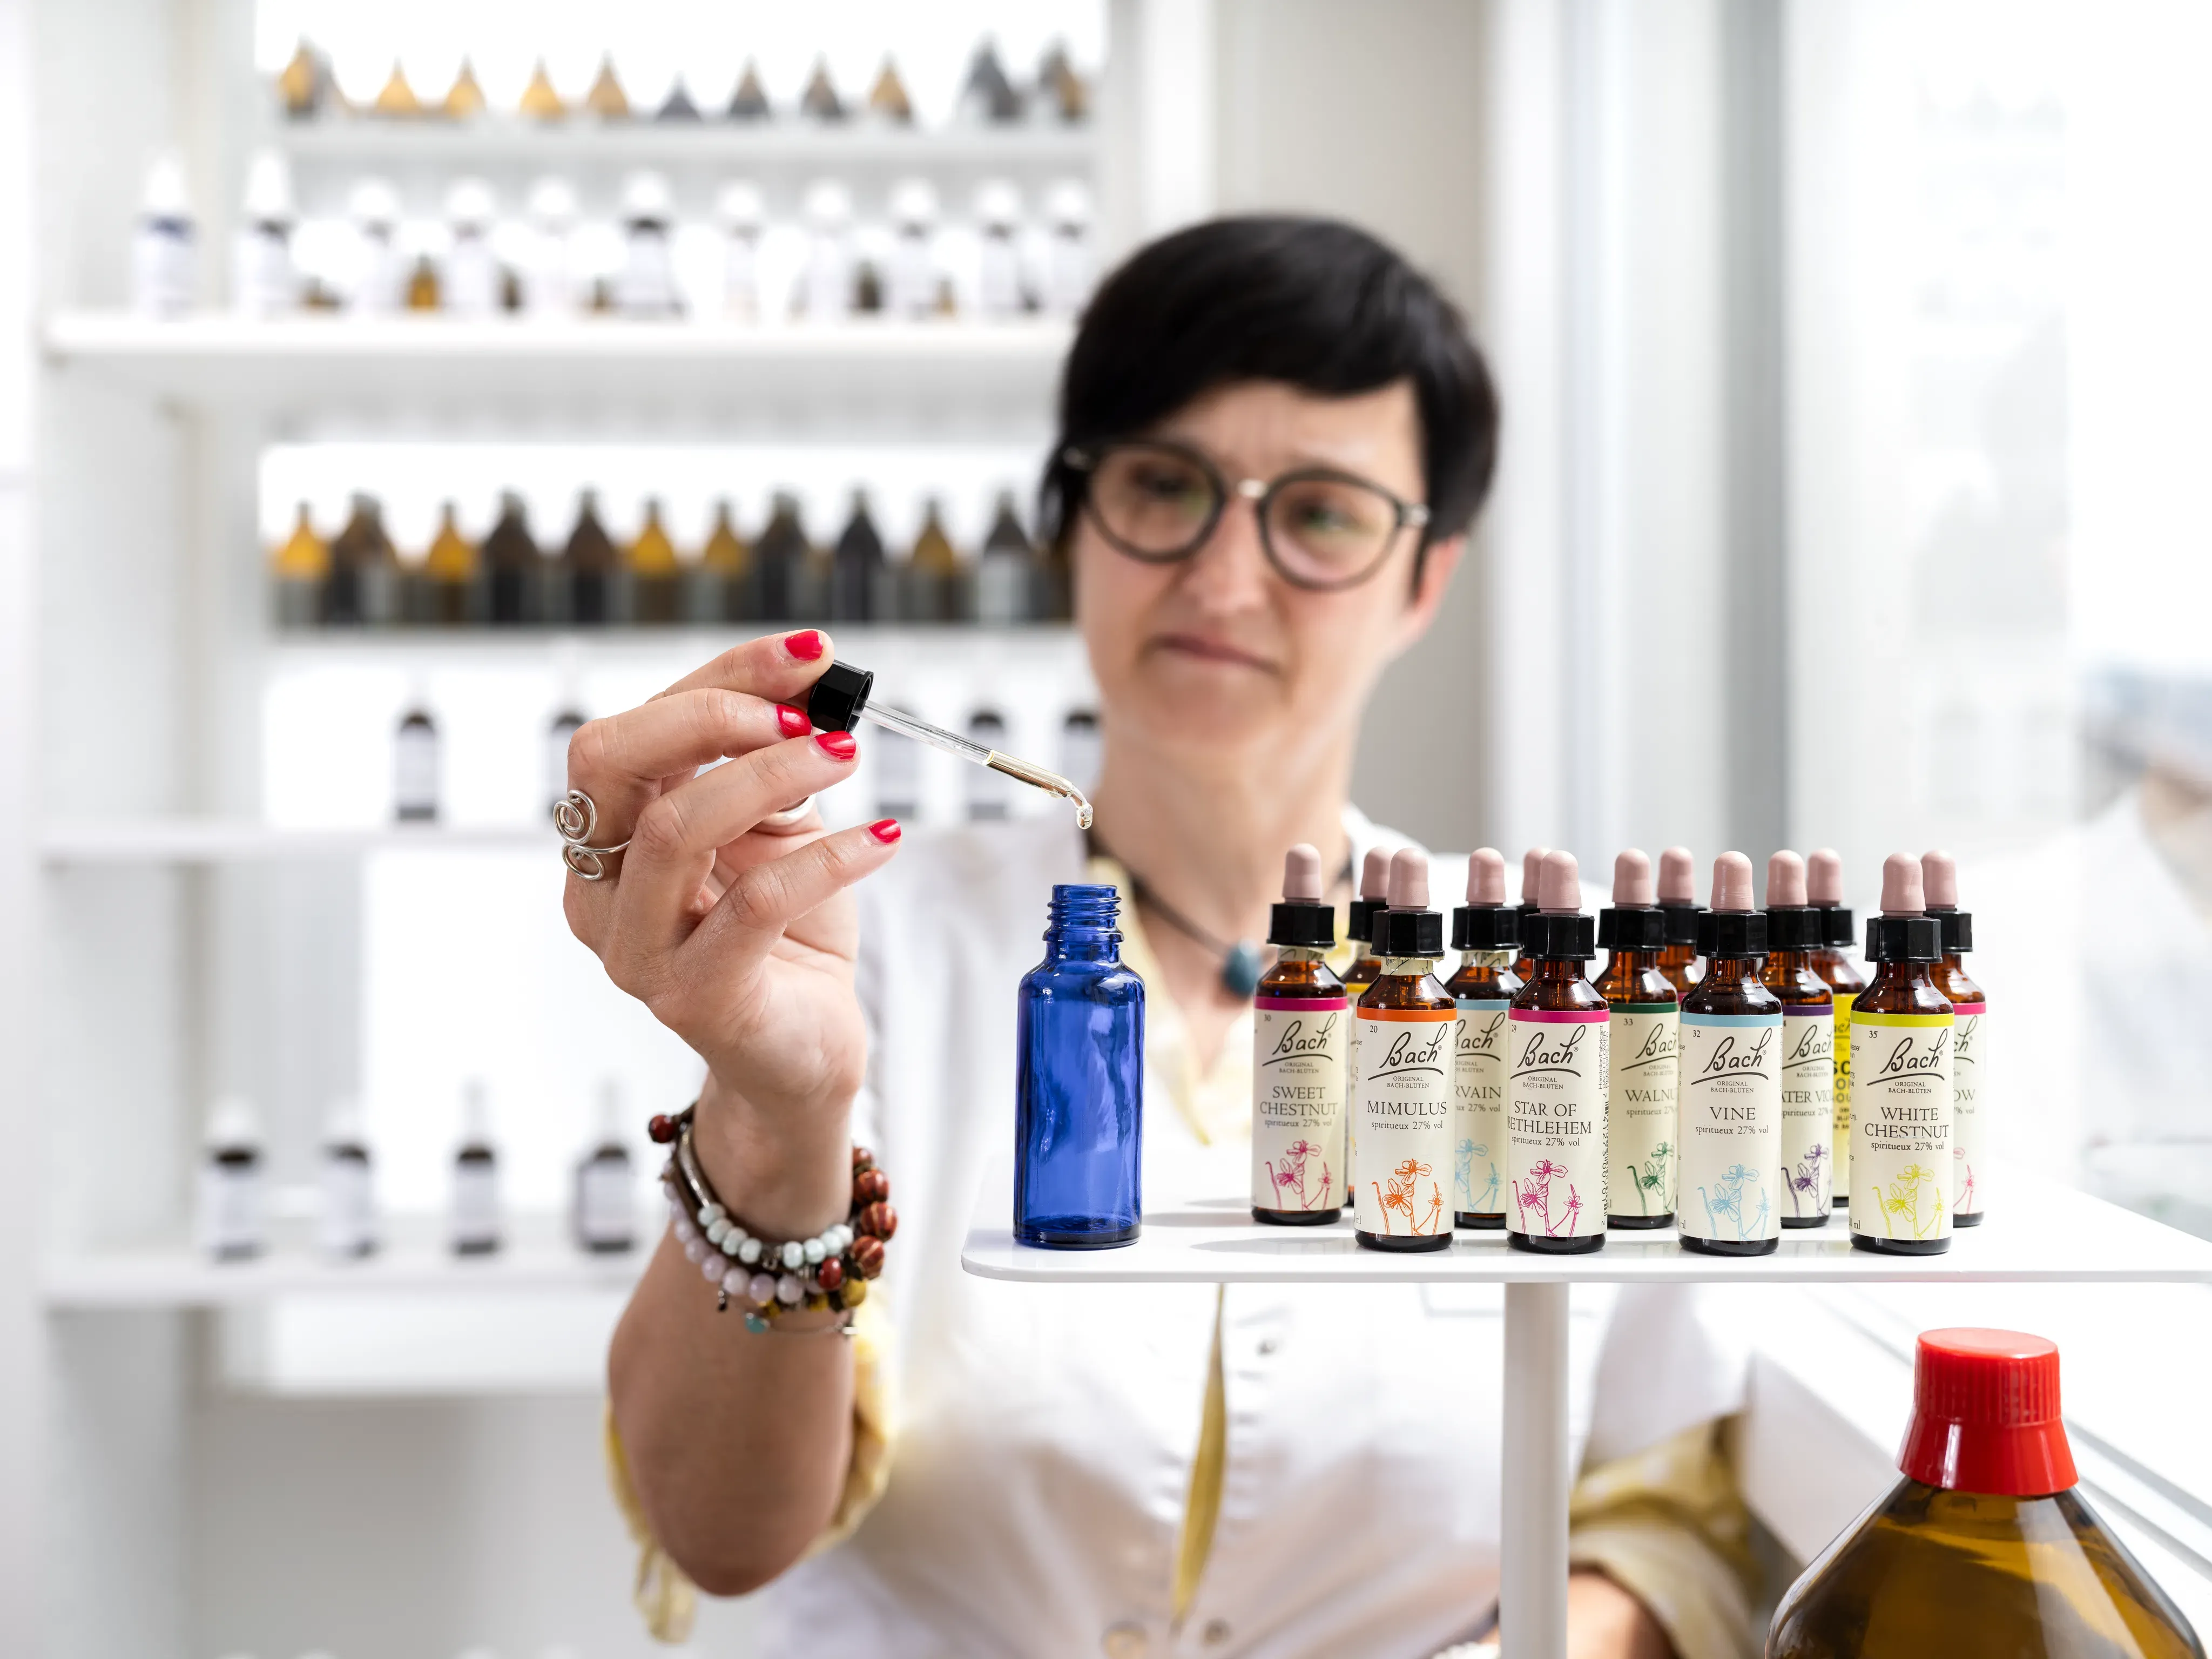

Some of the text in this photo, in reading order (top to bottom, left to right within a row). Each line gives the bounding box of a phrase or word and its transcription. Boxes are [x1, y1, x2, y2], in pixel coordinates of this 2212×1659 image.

[1370, 1025, 1378, 1033] 20
[1511, 1024, 1516, 1033] 29
[1693, 1029, 1701, 1037] 32
[1869, 1030, 1878, 1038] 35
[1272, 1085, 1325, 1099] SWEET
[1455, 1085, 1501, 1098] RVAIN
[1625, 1089, 1676, 1102] WALNU
[1259, 1101, 1338, 1116] CHESTNUT
[1367, 1100, 1447, 1115] MIMULUS
[1468, 1103, 1486, 1112] 27%
[1489, 1104, 1500, 1112] vol
[1514, 1101, 1576, 1117] STAR OF
[1626, 1107, 1661, 1118] spiritueux
[1710, 1107, 1756, 1120] VINE
[1880, 1107, 1938, 1121] WHITE
[1265, 1118, 1332, 1128] spiritueux 27% vol
[1371, 1120, 1443, 1130] spiritueux 27% vol
[1508, 1116, 1591, 1134] BETHLEHEM
[1695, 1125, 1768, 1135] spiritueux 27% vol
[1865, 1123, 1949, 1138] CHESTNUT
[1512, 1135, 1580, 1146] spiritueux 27% vol
[1871, 1141, 1944, 1151] spiritueux 27% vol
